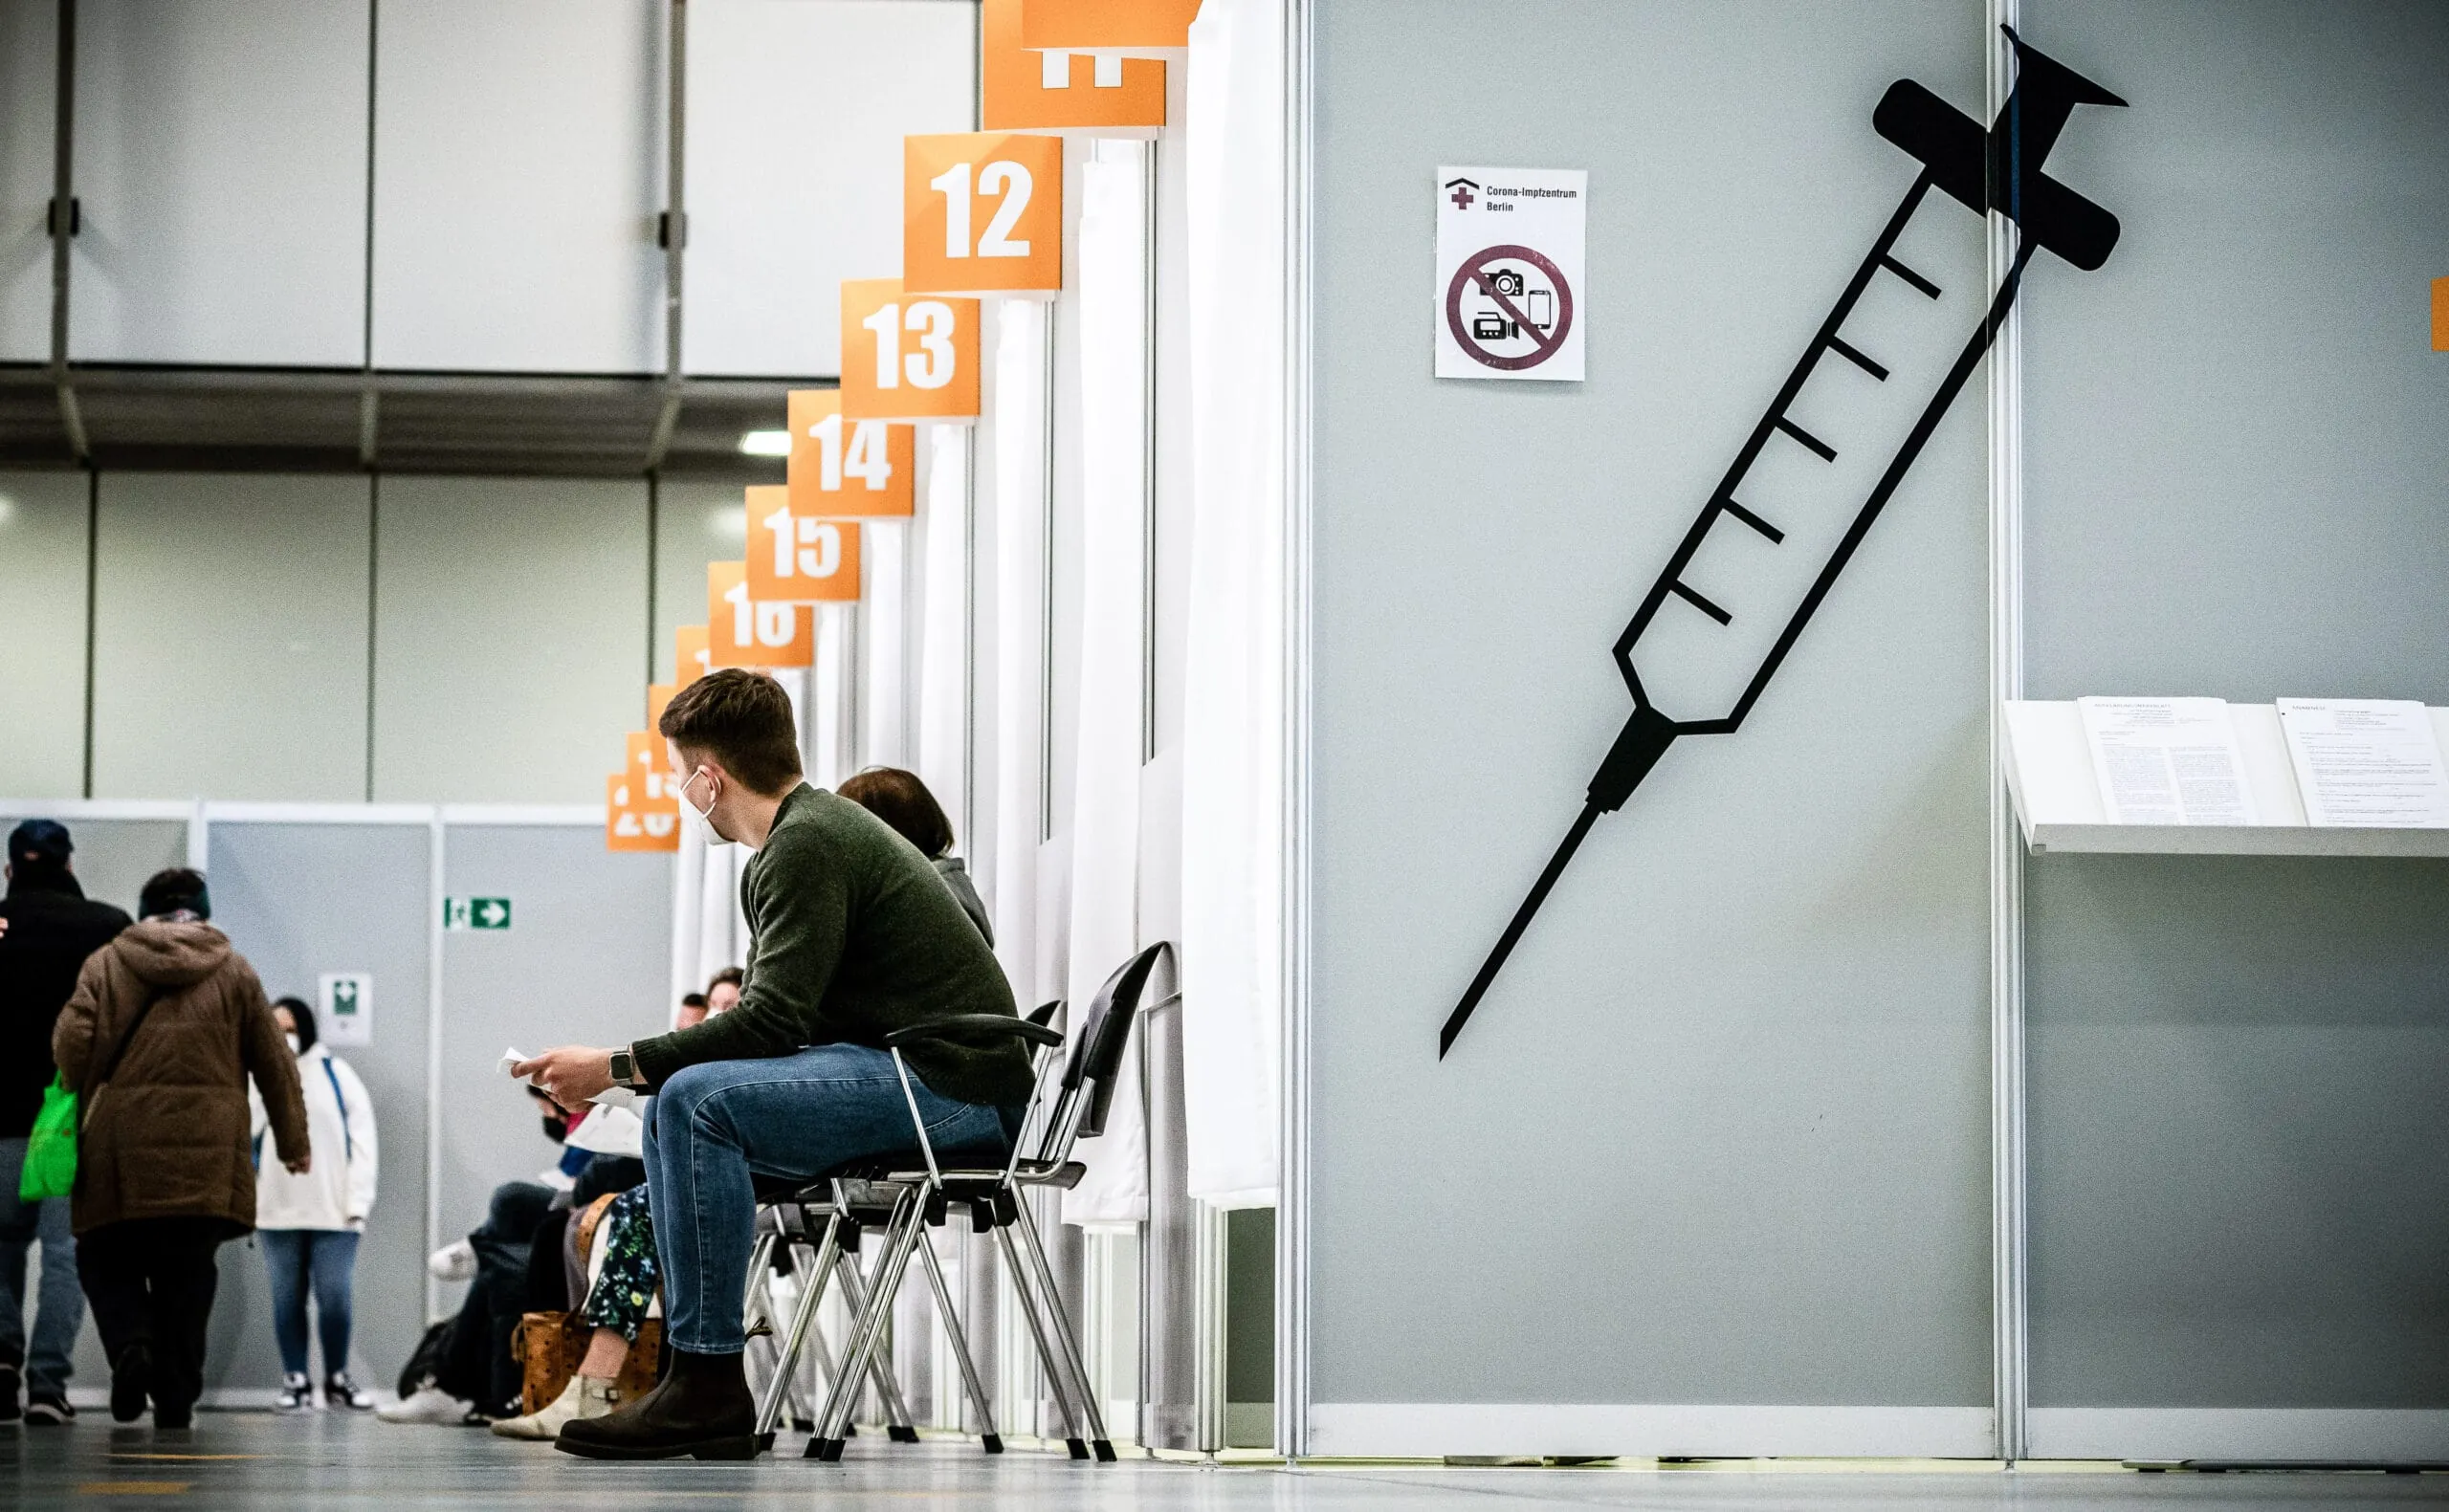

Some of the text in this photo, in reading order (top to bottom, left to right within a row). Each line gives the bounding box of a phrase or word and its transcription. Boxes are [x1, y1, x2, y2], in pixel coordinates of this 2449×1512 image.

[931, 161, 1033, 258] 12
[1487, 186, 1578, 199] Corona-Impfzentrum
[1487, 202, 1513, 212] Berlin
[862, 301, 955, 389] 13
[809, 413, 892, 491] 14
[763, 506, 841, 578] 15
